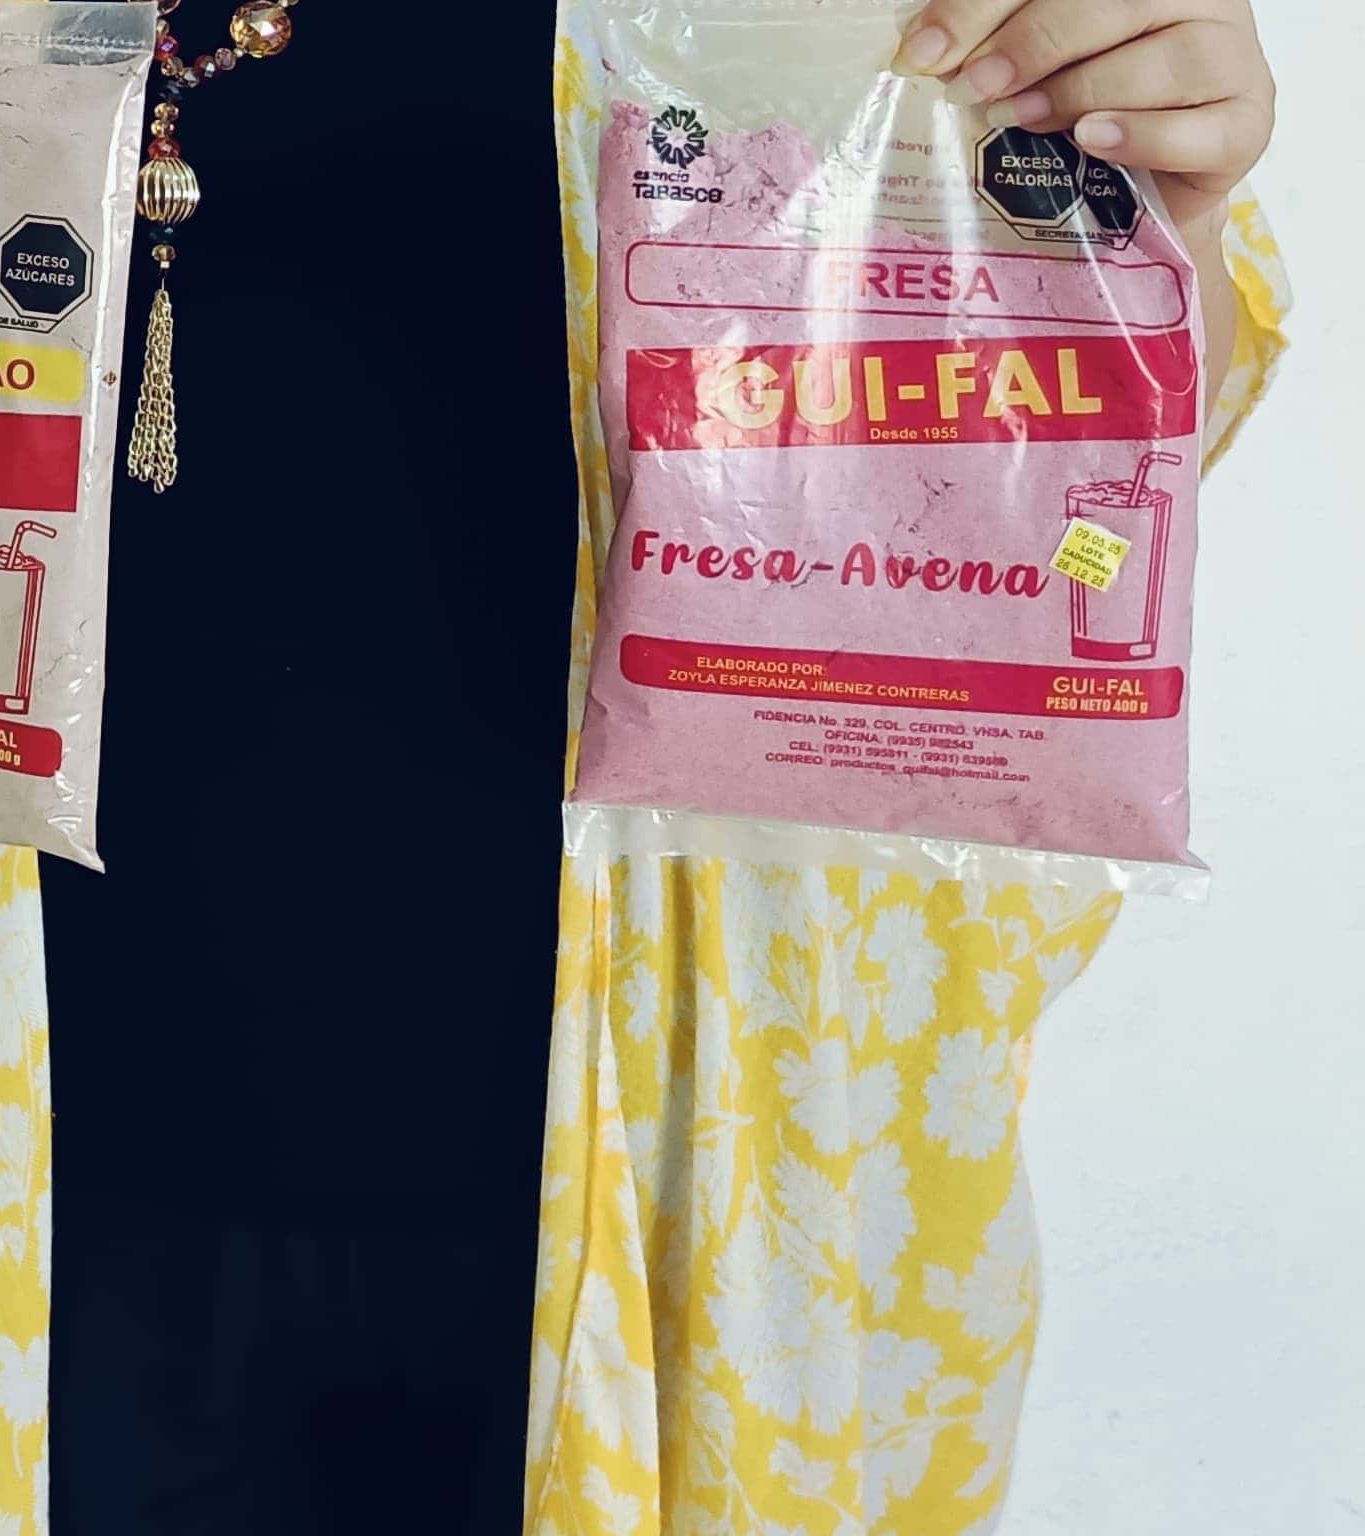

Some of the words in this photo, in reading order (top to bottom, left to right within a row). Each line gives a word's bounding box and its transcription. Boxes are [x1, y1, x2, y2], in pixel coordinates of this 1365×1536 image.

[1001, 154, 1066, 170] EXCESO
[17, 252, 70, 270] EXCESO
[6, 266, 76, 286] AZÚCARES
[718, 347, 1104, 433] GUI-FAL
[869, 426, 919, 442] Desde
[922, 426, 959, 442] 1955
[1061, 547, 1112, 576] CADUCIDAD
[1081, 545, 1105, 560] LOTE
[696, 656, 789, 674] ELABORADO
[668, 669, 717, 685] ZOYLA
[718, 673, 808, 692] ESPERANZA
[810, 681, 874, 696] JIMENEZ
[876, 685, 971, 703] CONTRERAS
[1052, 675, 1146, 697] GUI-FAL
[1046, 696, 1078, 711] PESO
[1079, 698, 1111, 712] NETO
[1112, 699, 1138, 713] 400
[753, 710, 817, 726] FIDENCIA
